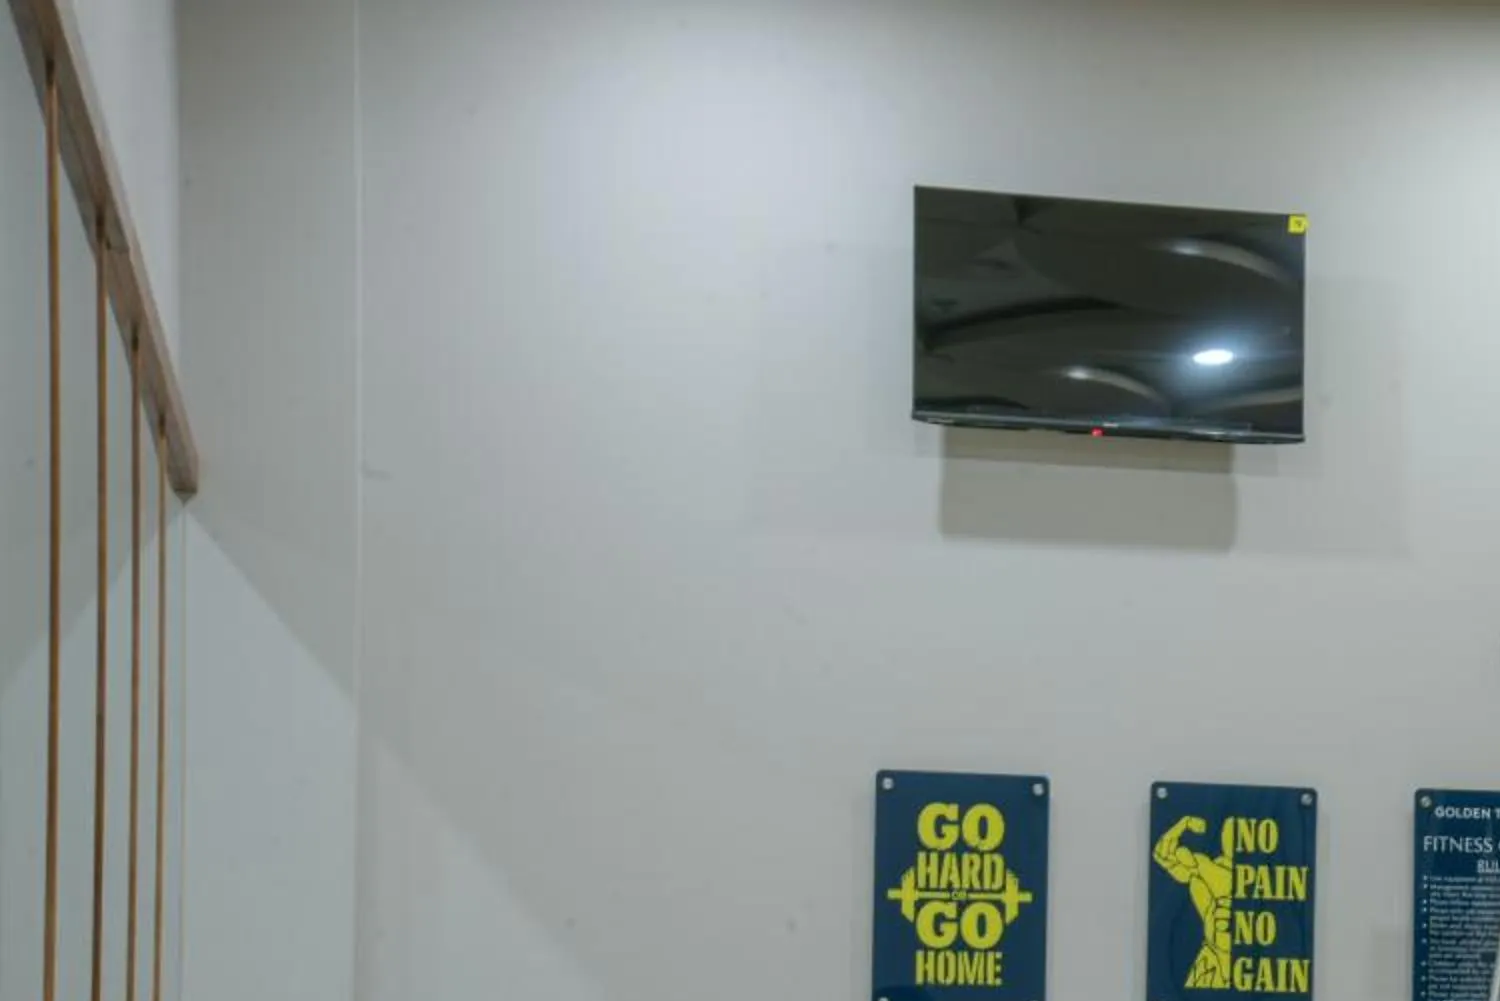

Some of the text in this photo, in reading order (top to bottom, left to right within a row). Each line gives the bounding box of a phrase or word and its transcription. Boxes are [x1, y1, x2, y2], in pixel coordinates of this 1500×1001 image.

[917, 802, 1005, 851] GO
[1434, 805, 1491, 820] GOLDEN
[1235, 817, 1279, 853] NO
[1423, 835, 1493, 853] FITNESS
[917, 851, 1005, 890] HARD
[1235, 864, 1309, 901] PAIN
[916, 900, 1004, 949] GO
[1233, 911, 1277, 945] NO
[915, 949, 1003, 986] HOME
[1232, 956, 1310, 993] GAIN
